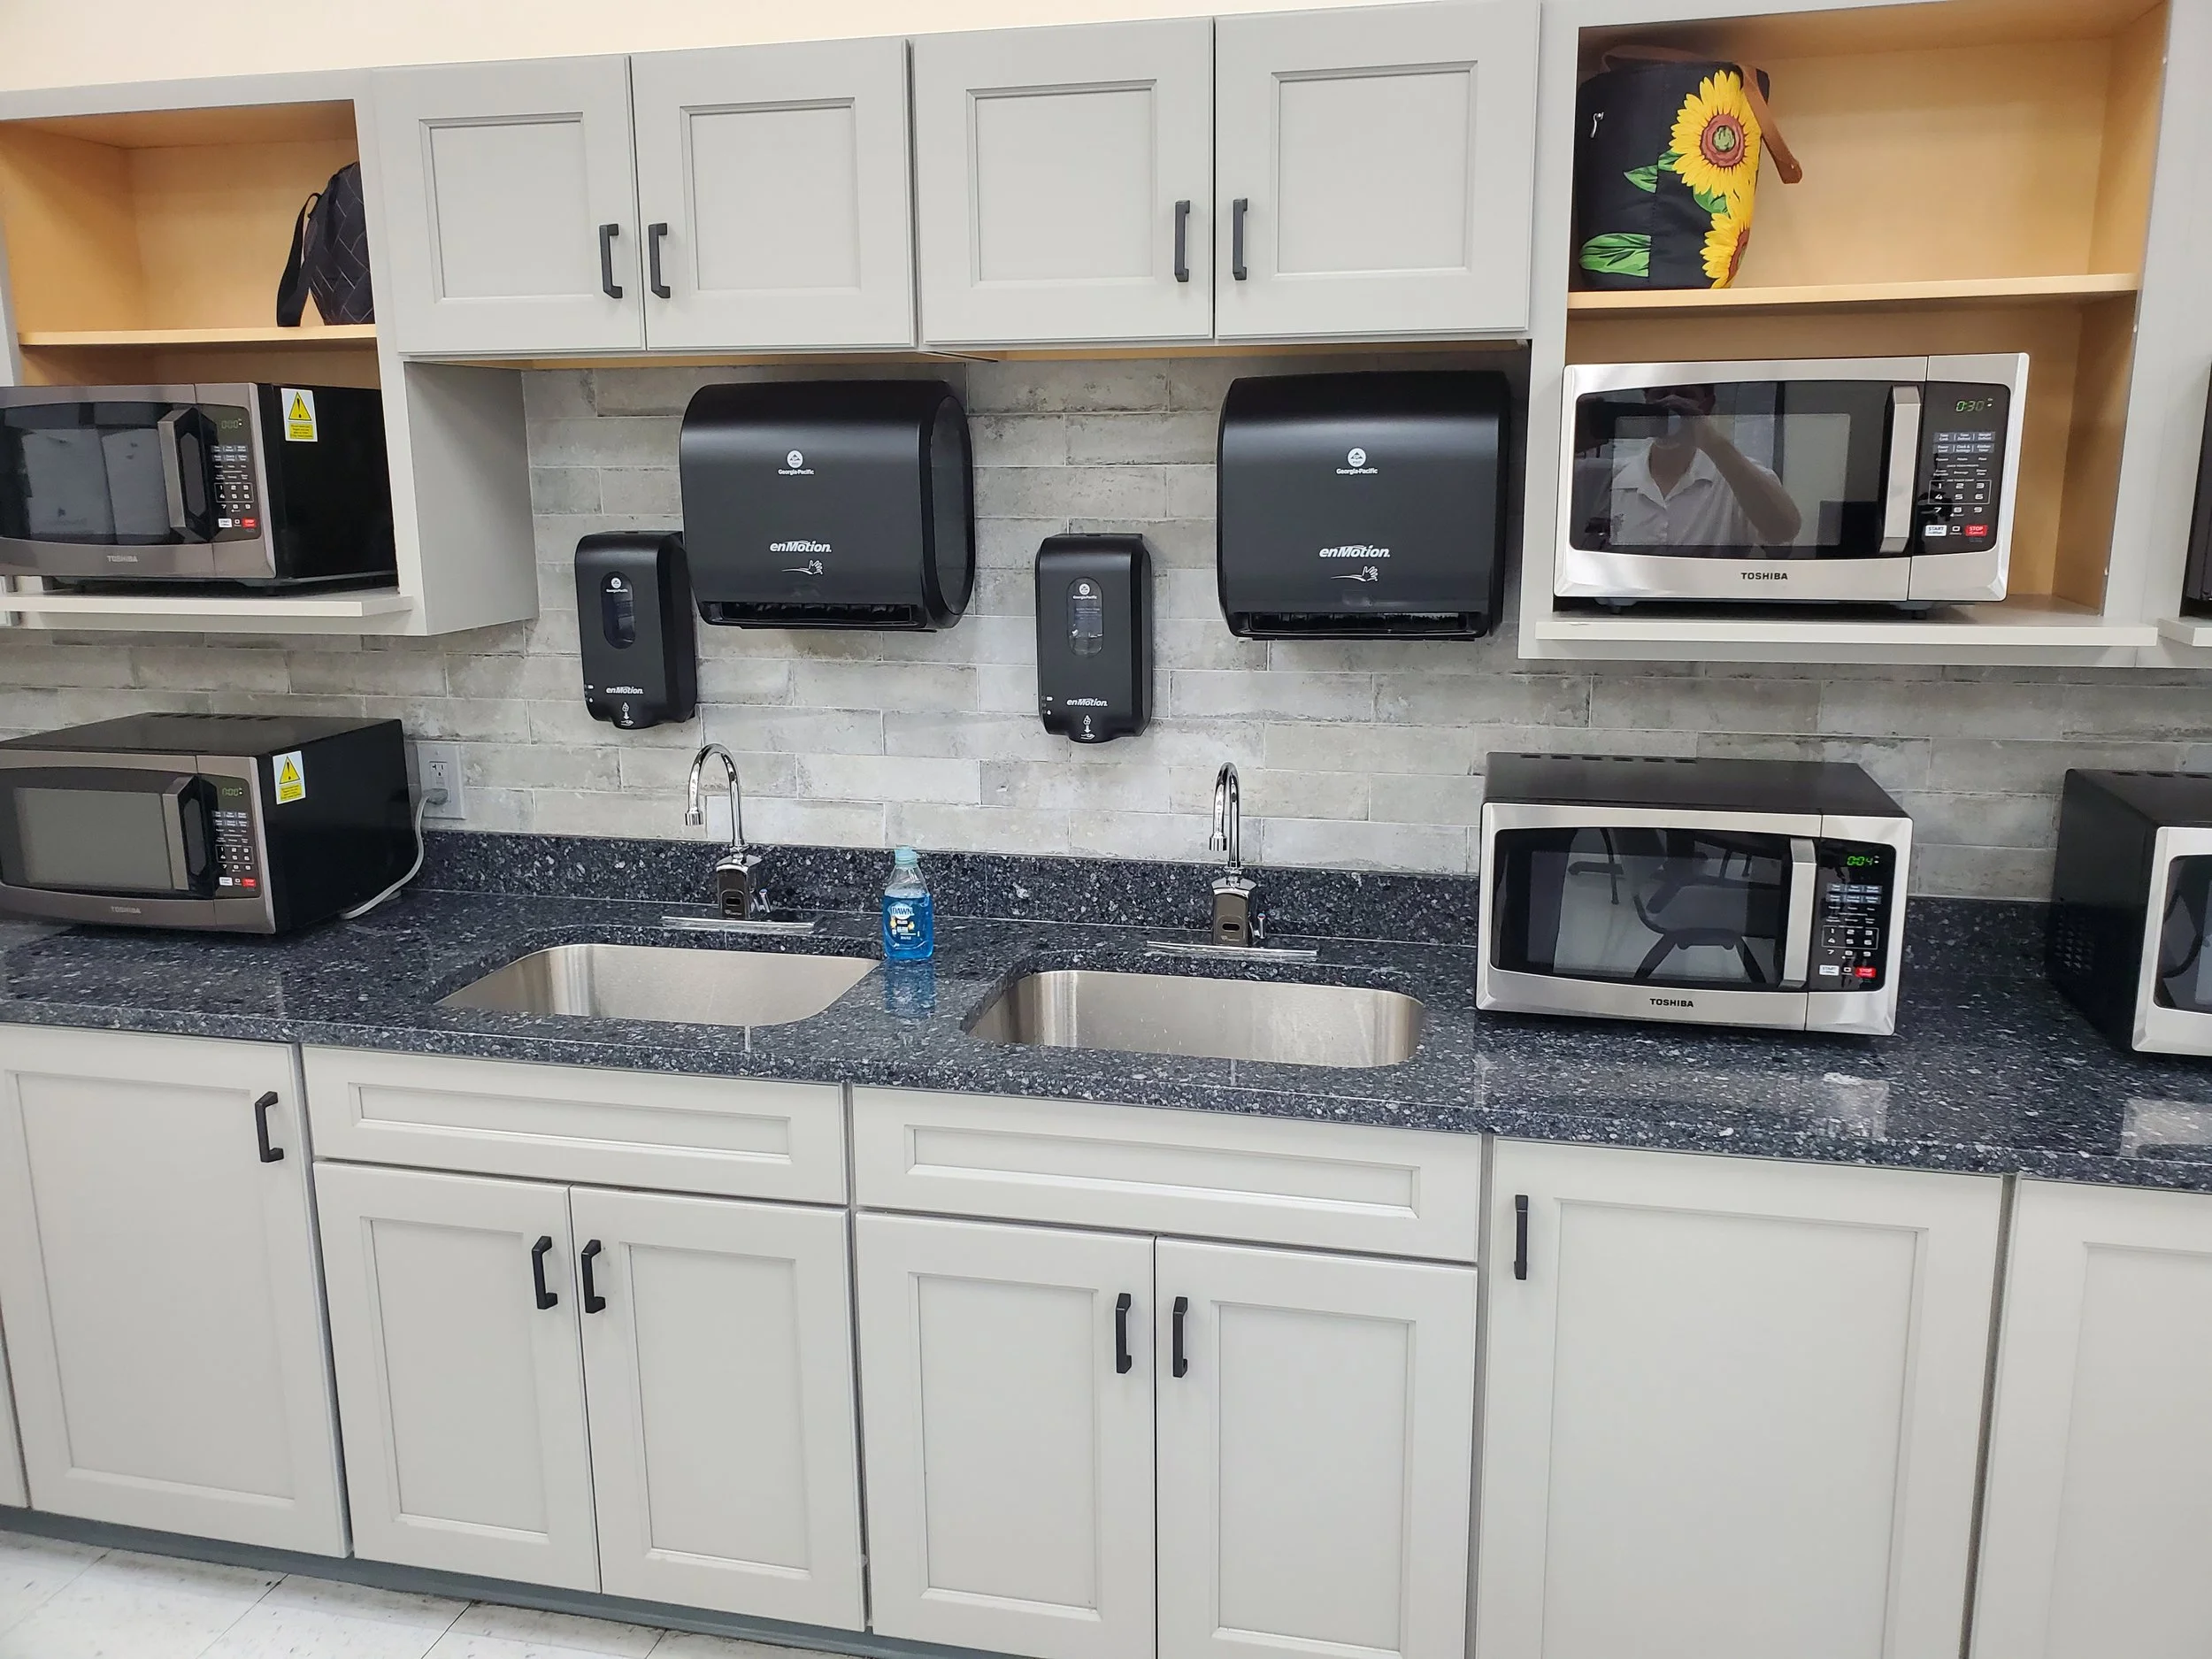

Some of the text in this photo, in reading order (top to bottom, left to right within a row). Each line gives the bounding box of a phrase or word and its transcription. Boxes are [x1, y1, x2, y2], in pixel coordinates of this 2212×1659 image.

[1955, 401, 1985, 411] 0:30
[1740, 572, 1788, 580] TOSHIBA
[892, 906, 914, 916] DAWN
[1648, 998, 1694, 1008] TOSHIBA
